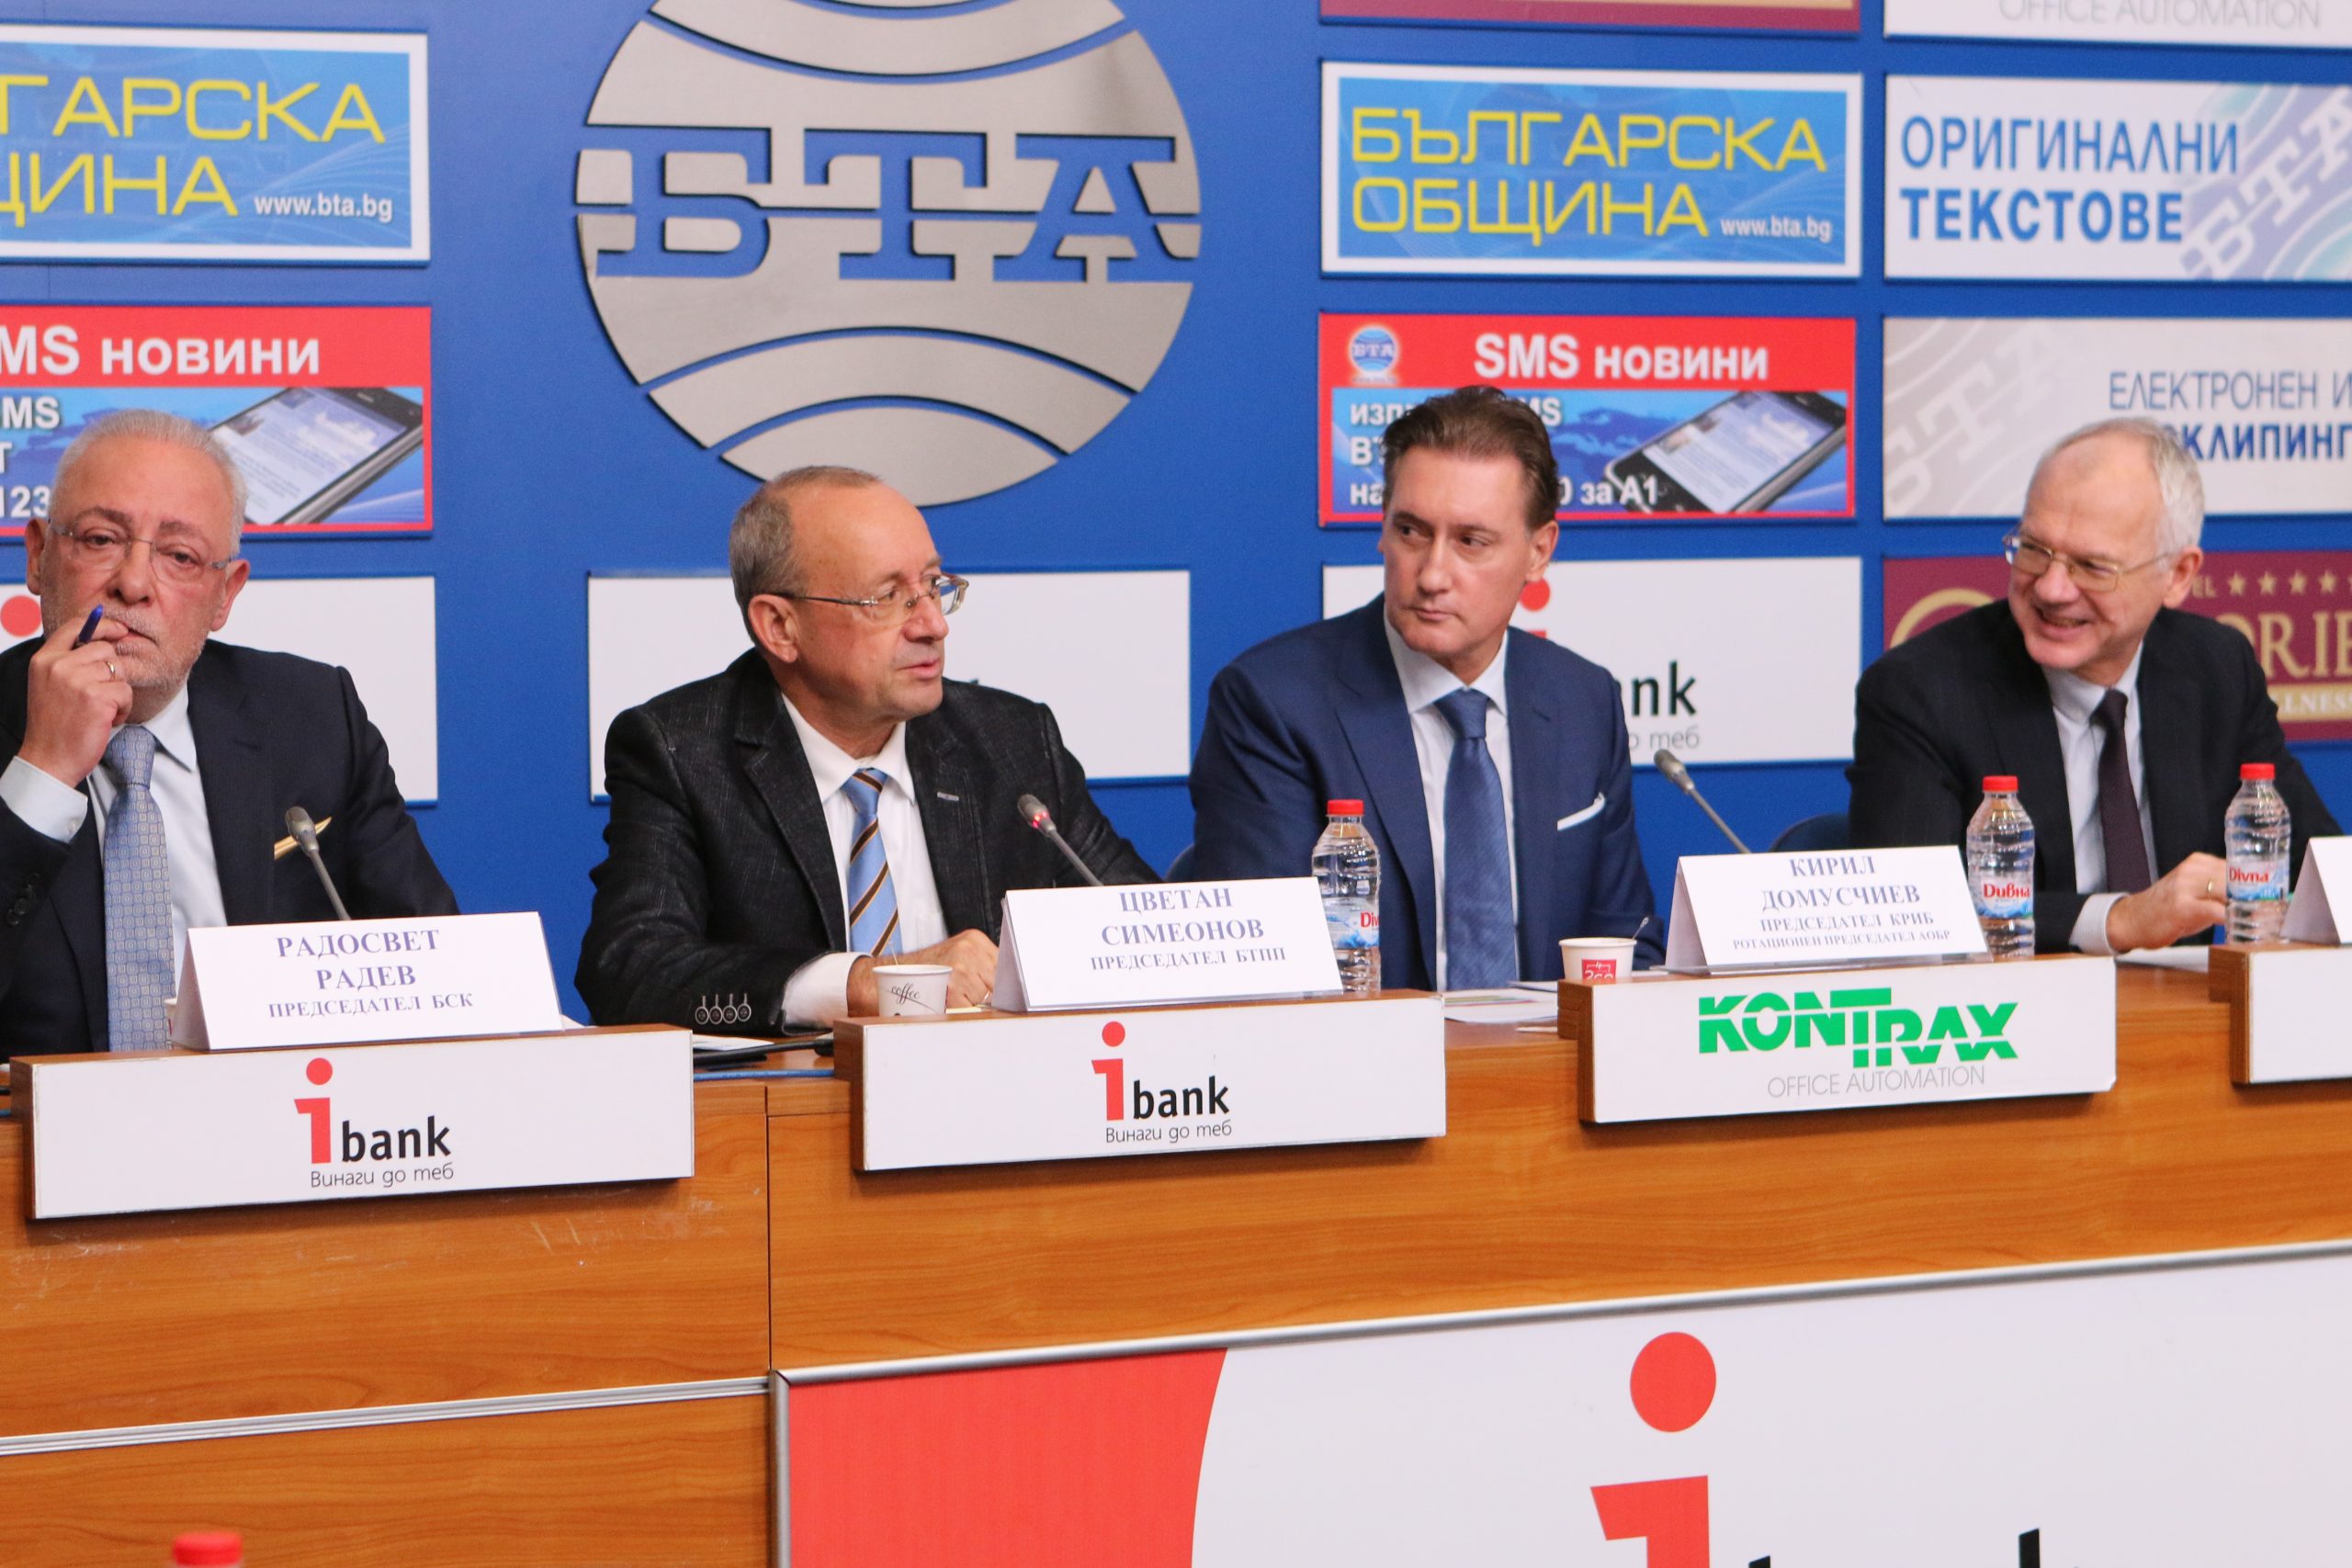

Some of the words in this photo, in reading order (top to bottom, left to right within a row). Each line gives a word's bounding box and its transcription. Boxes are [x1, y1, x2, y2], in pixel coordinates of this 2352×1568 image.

[1352, 107, 1826, 172] БЪЛГАРСКА
[1901, 116, 2237, 174] ОРИГИНАЛНИ
[254, 193, 392, 222] www.bta.bg
[1352, 177, 1709, 246] ОБЩИНА
[1899, 188, 2183, 242] ТЕКСТОВЕ
[1720, 215, 1832, 243] www.bta.bg
[101, 338, 319, 375] новини
[1474, 333, 1579, 378] SMS
[1594, 345, 1769, 380] новини
[2109, 371, 2318, 410] ЕЛЕКТРОНЕН
[1789, 855, 1875, 877] КИРИЛ
[1119, 887, 1232, 915] ЦВЕТАН
[1762, 885, 1920, 912] ДОМУСЧИЕВ
[1102, 919, 1264, 946] СИМЕОНОВ
[1760, 913, 1882, 932] ПРЕДСЕДАТЕЛ
[1889, 911, 1934, 927] КРИБ
[276, 930, 440, 959] РАДОСВЕТ
[1733, 935, 1822, 950] РОТАЦИОНЕН
[1825, 931, 1916, 947] ПРЕДСЕДАТЕЛ
[1091, 950, 1227, 971] ПРЕДСЕДАТЕЛ
[1235, 947, 1286, 963] БТПП
[316, 965, 416, 991] РАДЕВ
[268, 996, 422, 1018] ПРЕДСЕДАТЕЛ
[432, 993, 473, 1010] БСК
[891, 982, 920, 1006] coffee
[1699, 987, 2018, 1068] KONTRAX
[1767, 1073, 1840, 1098] OFFICE
[1846, 1065, 1986, 1094] AUTOMATION
